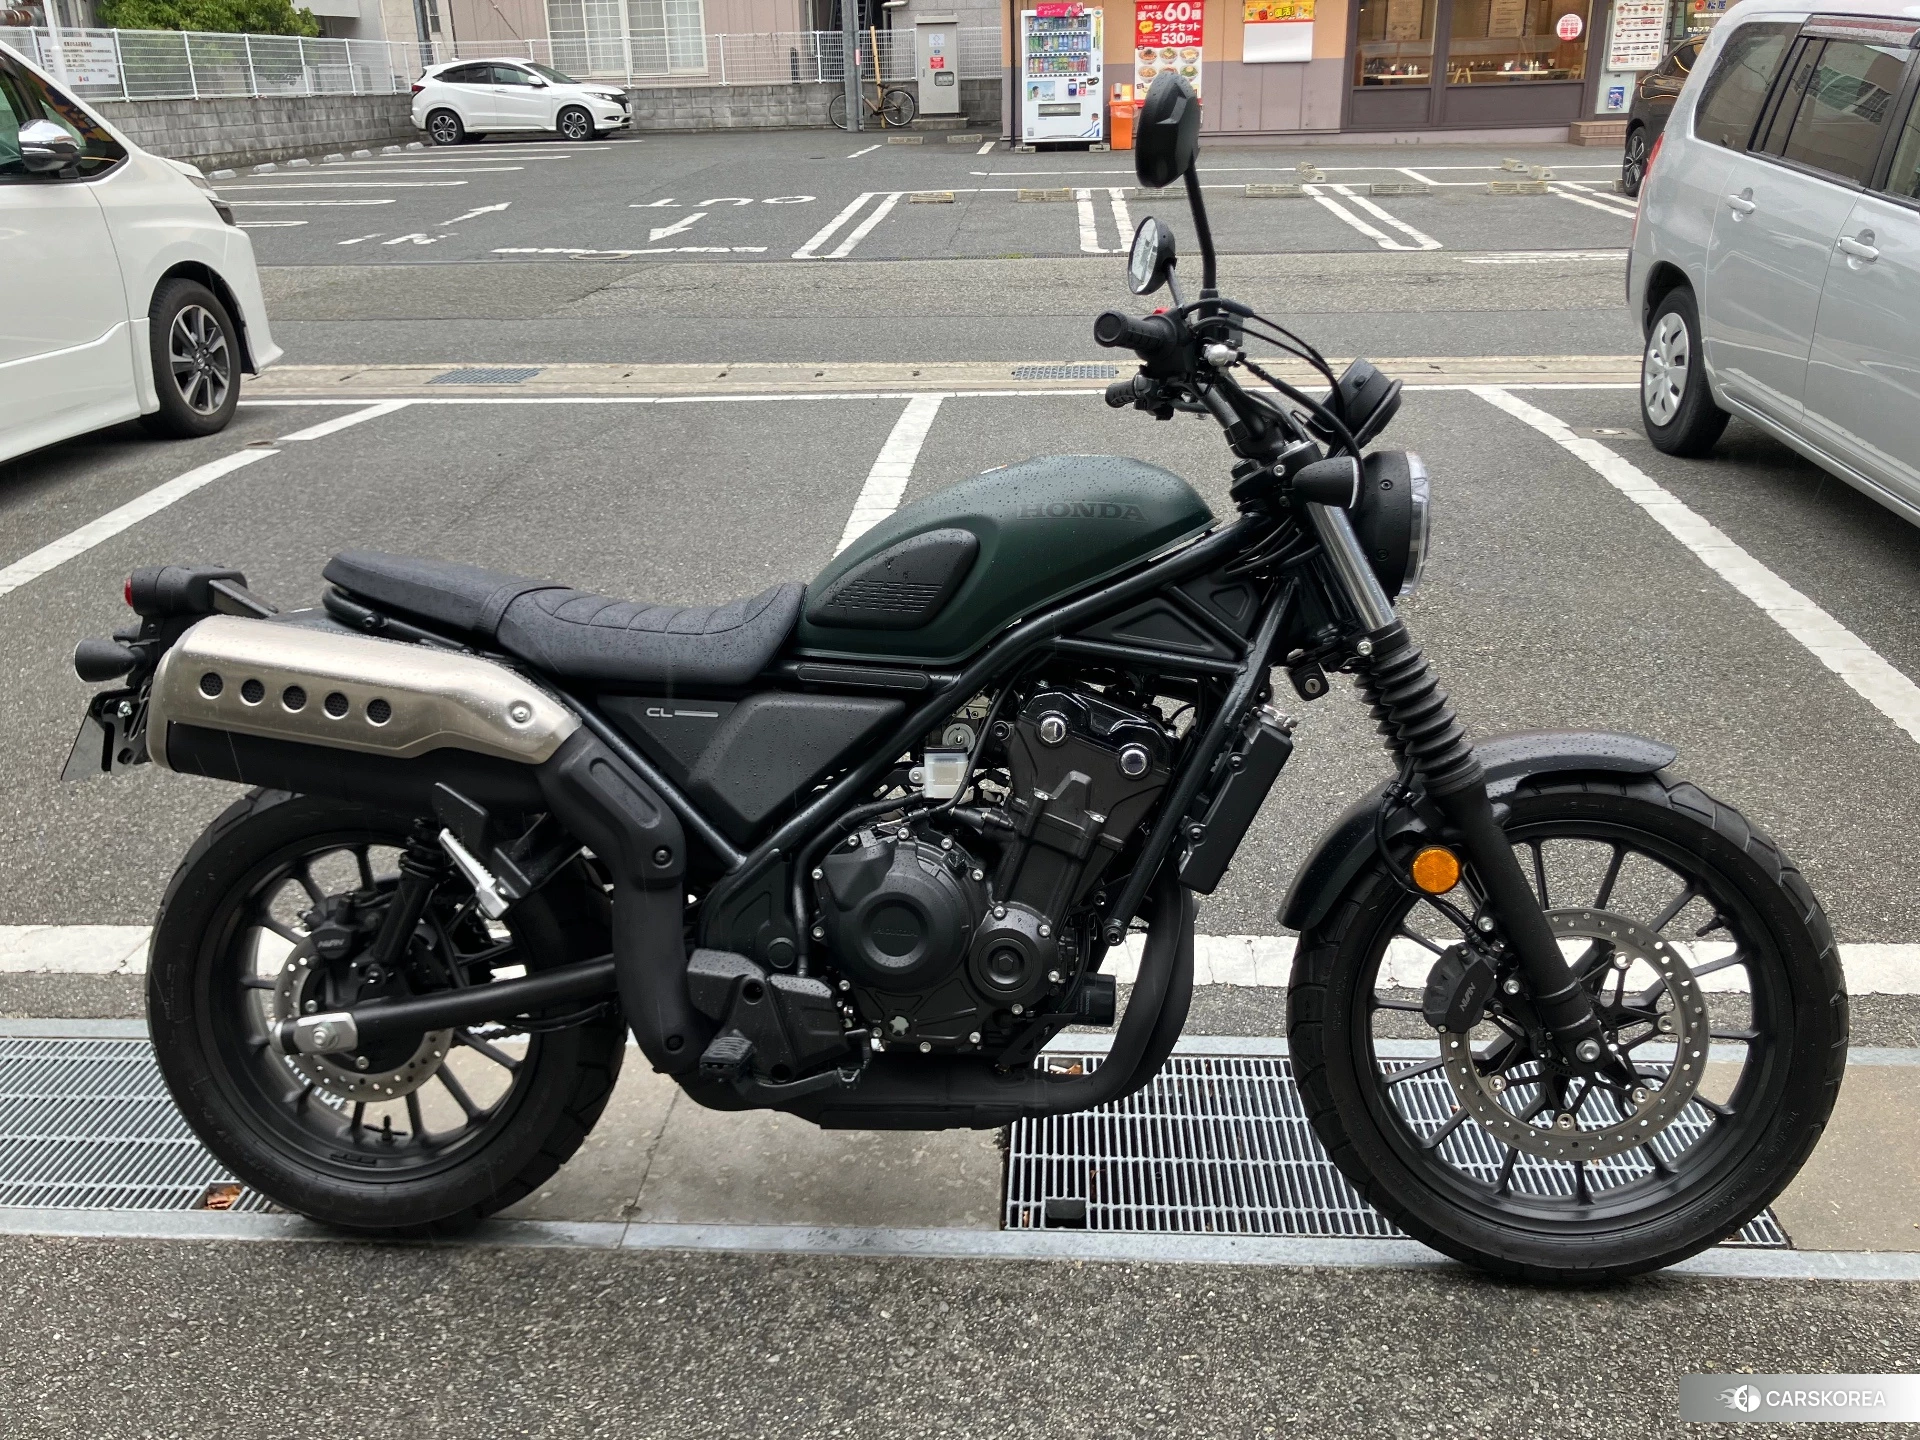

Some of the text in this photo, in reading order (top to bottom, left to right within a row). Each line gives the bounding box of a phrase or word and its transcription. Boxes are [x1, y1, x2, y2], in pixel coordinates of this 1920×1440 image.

[1153, 22, 1201, 32] ランチセット
[1018, 501, 1147, 522] HONDA
[646, 707, 674, 718] CL
